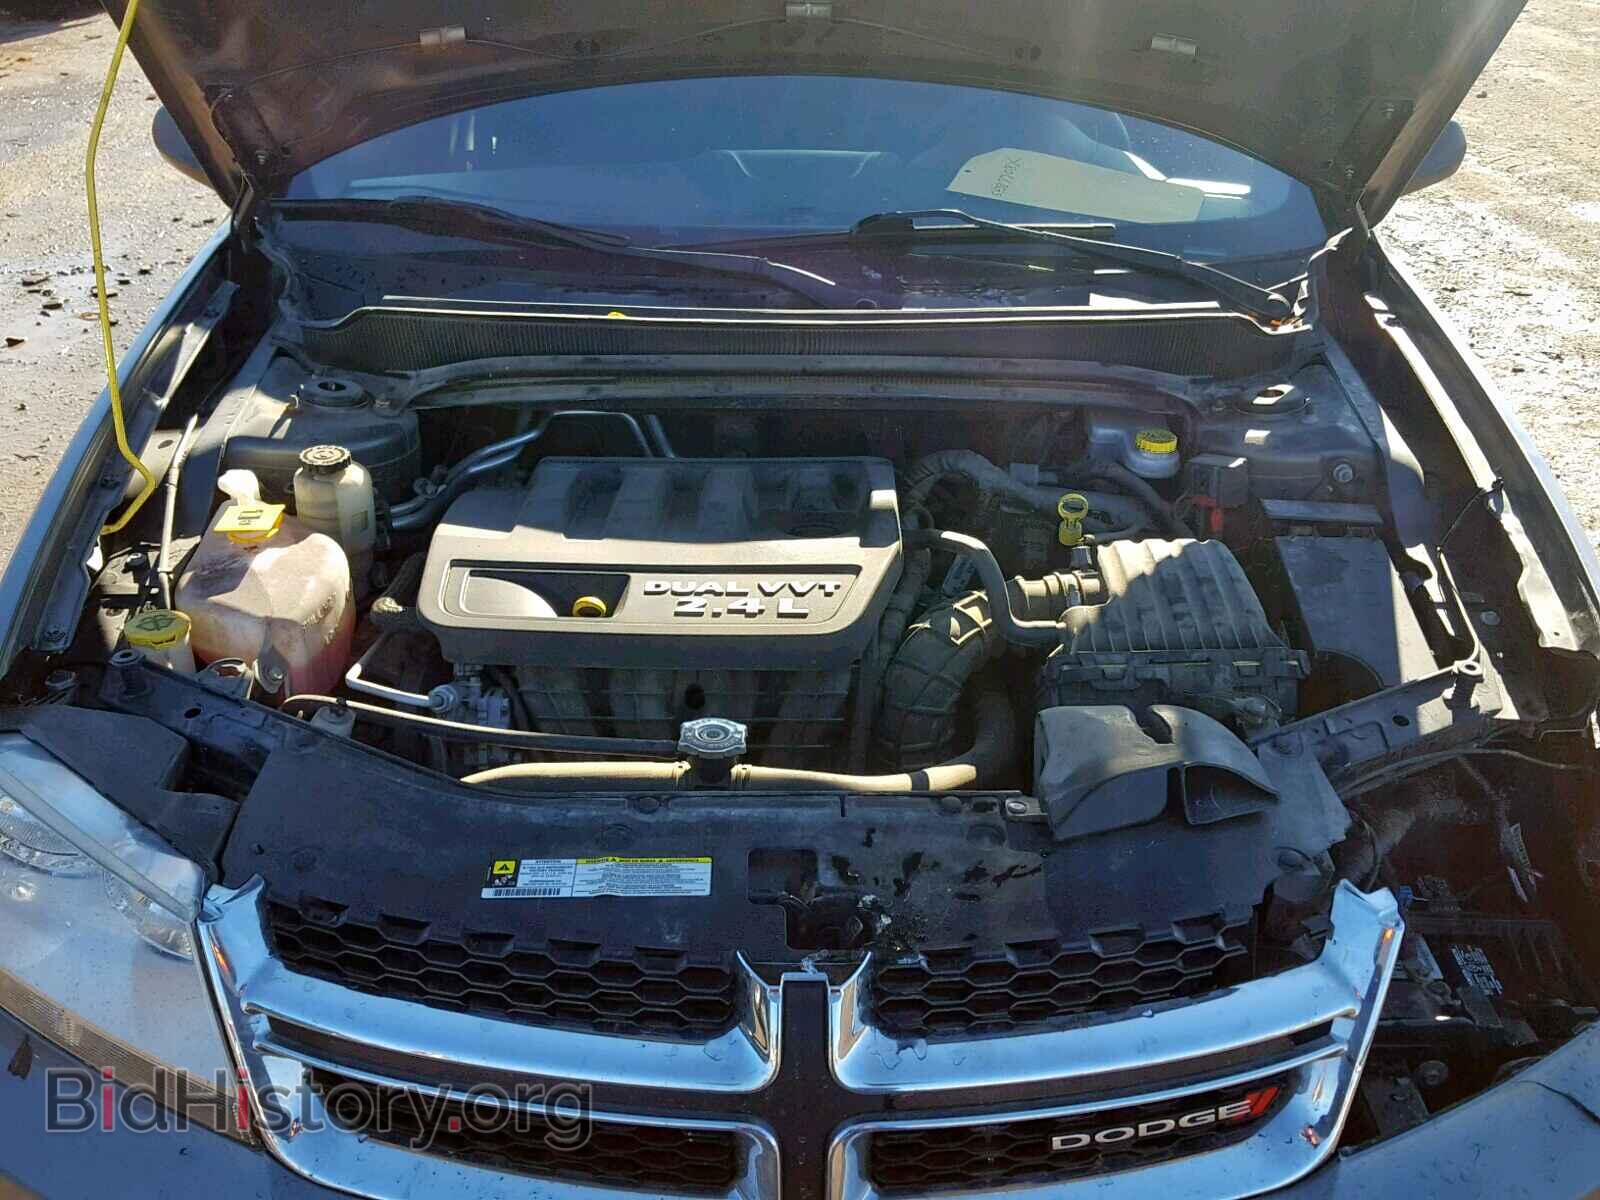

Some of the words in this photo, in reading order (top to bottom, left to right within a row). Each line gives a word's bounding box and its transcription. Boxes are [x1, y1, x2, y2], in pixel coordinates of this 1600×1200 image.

[643, 580, 749, 597] DUAL
[757, 580, 841, 597] VVT
[1051, 1100, 1251, 1150] DODGE
